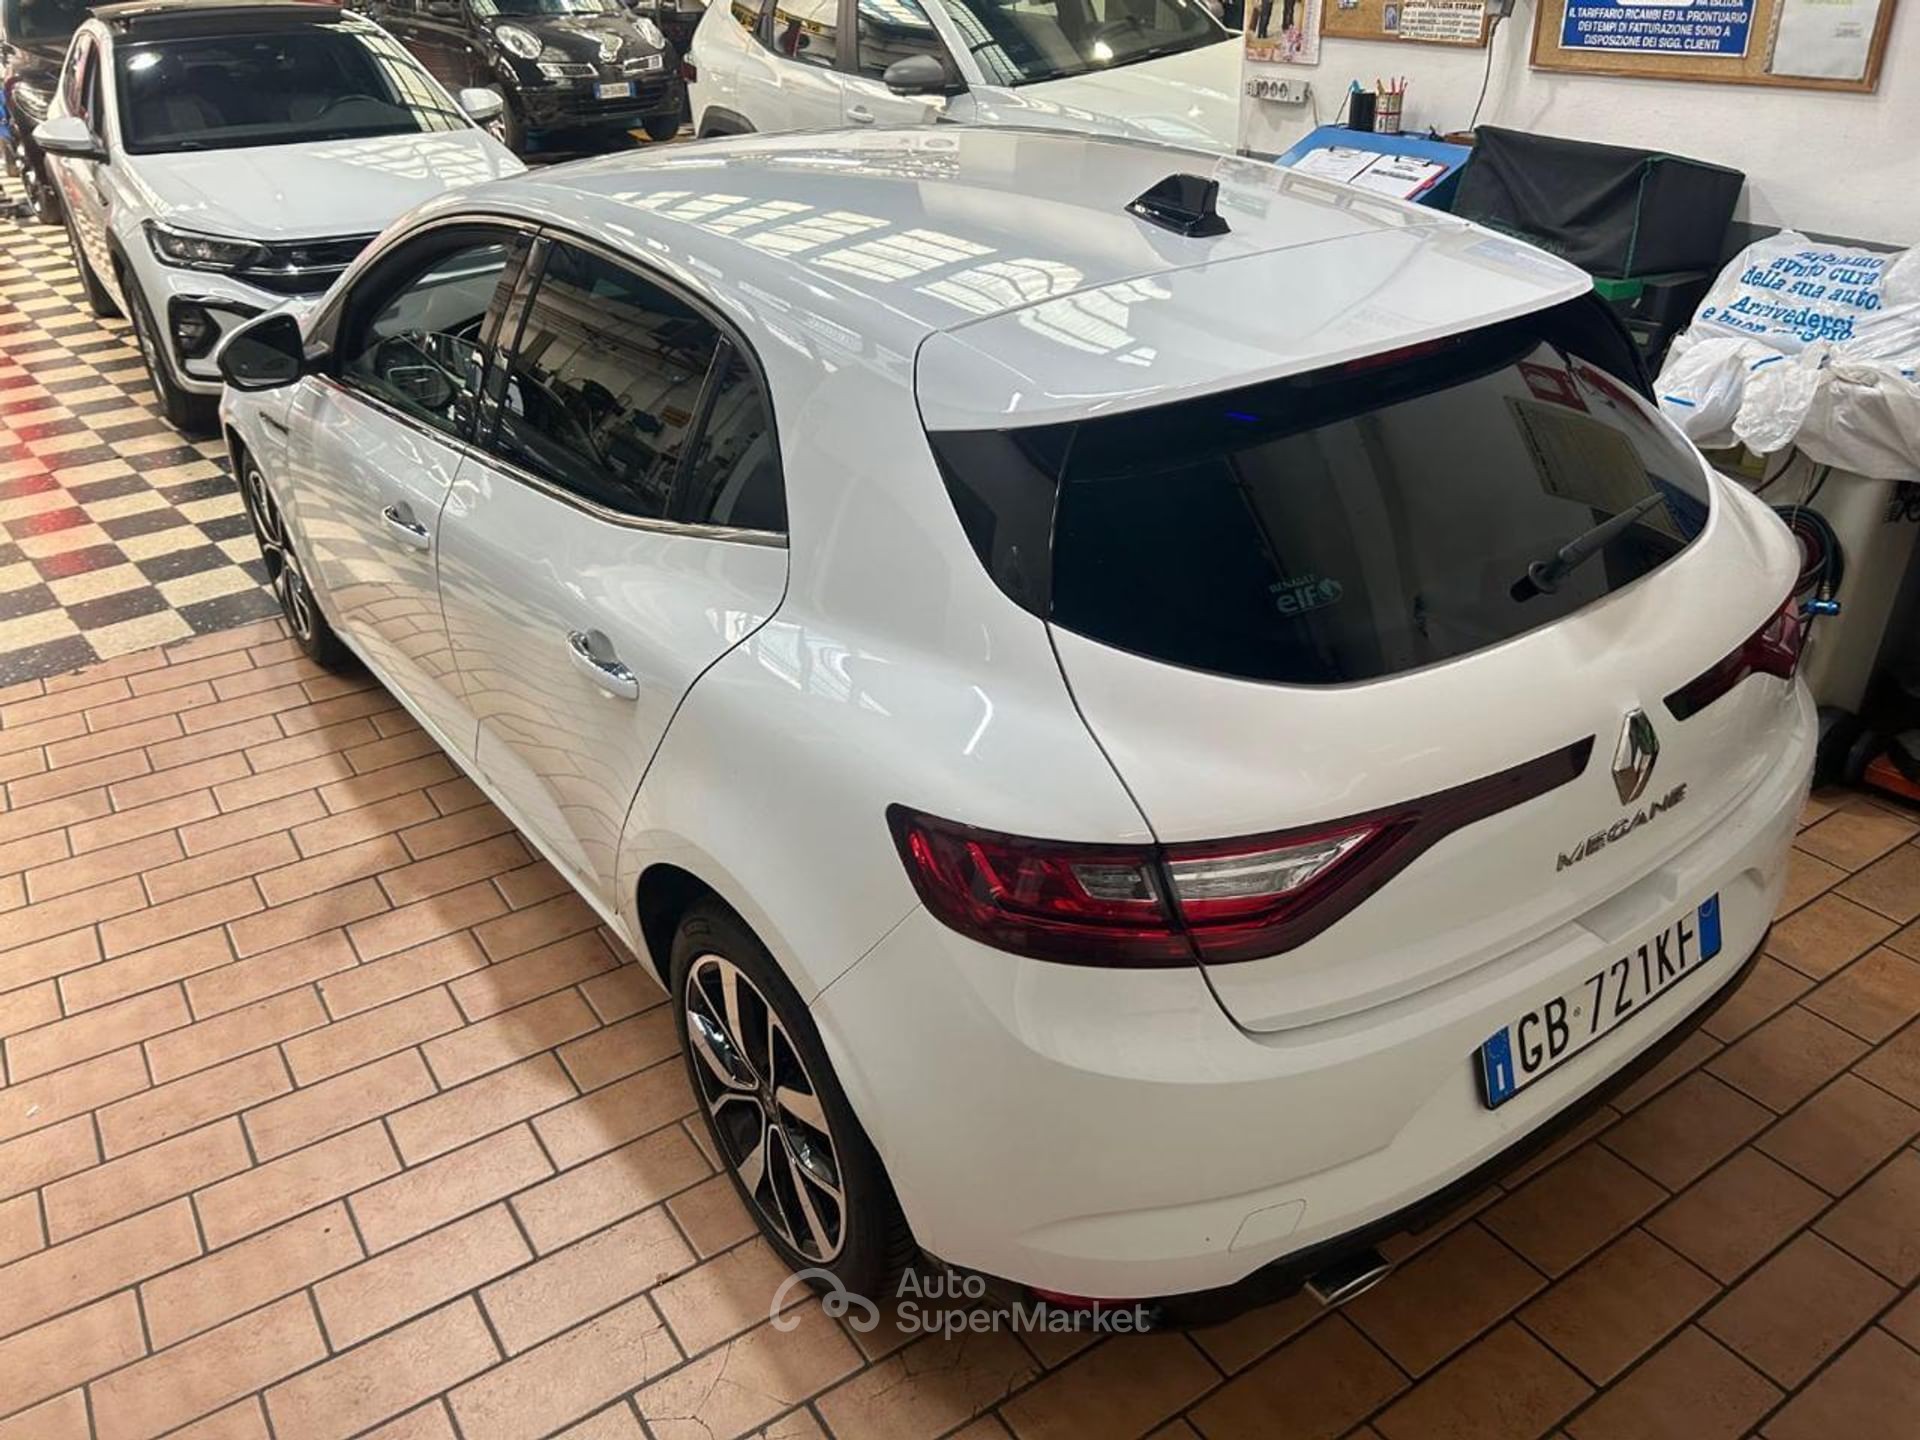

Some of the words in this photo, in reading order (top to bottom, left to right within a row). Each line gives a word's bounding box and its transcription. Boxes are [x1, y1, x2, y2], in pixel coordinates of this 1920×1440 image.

[1577, 8, 1624, 19] TARIFFARIO
[1624, 9, 1661, 20] RICAMBI
[1662, 10, 1675, 21] ED
[1676, 11, 1685, 21] IL
[1686, 11, 1748, 24] PRONTUARIO
[1578, 21, 1591, 31] DEI
[1592, 21, 1618, 32] TEMPI
[1618, 22, 1627, 32] DI
[1628, 22, 1694, 35] FATTURAZIONE
[1695, 25, 1722, 36] SONO
[1723, 26, 1731, 37] A
[1584, 34, 1641, 47] DISPOSIZIONE
[1642, 36, 1657, 48] DEI
[1658, 37, 1683, 49] SIGG.
[1684, 38, 1720, 50] CLIENTI
[1740, 265, 1786, 291] della
[1787, 279, 1826, 299] sua
[1829, 265, 1879, 285] cura
[1702, 307, 1716, 320] e
[1716, 310, 1767, 333] buon
[1729, 295, 1856, 331] Arrivederci
[1556, 782, 1687, 872] MEGANE
[1517, 996, 1570, 1074] GB
[1584, 910, 1694, 1034] 721KF
